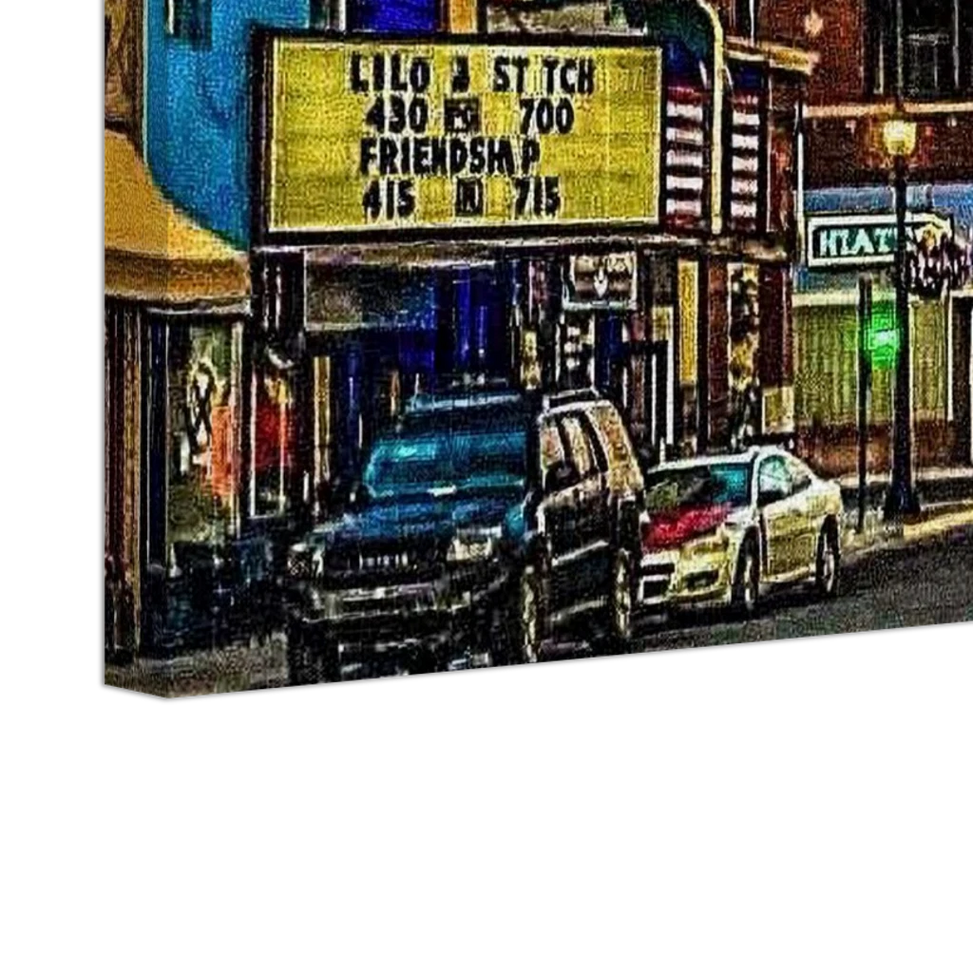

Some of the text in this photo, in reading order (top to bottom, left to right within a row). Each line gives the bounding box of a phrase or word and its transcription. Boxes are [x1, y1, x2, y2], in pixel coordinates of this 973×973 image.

[350, 52, 431, 93] LILO
[366, 95, 428, 134] 430
[519, 96, 575, 135] 700
[363, 178, 416, 220] 415
[514, 177, 562, 219] 715
[819, 227, 900, 257] HIAT
